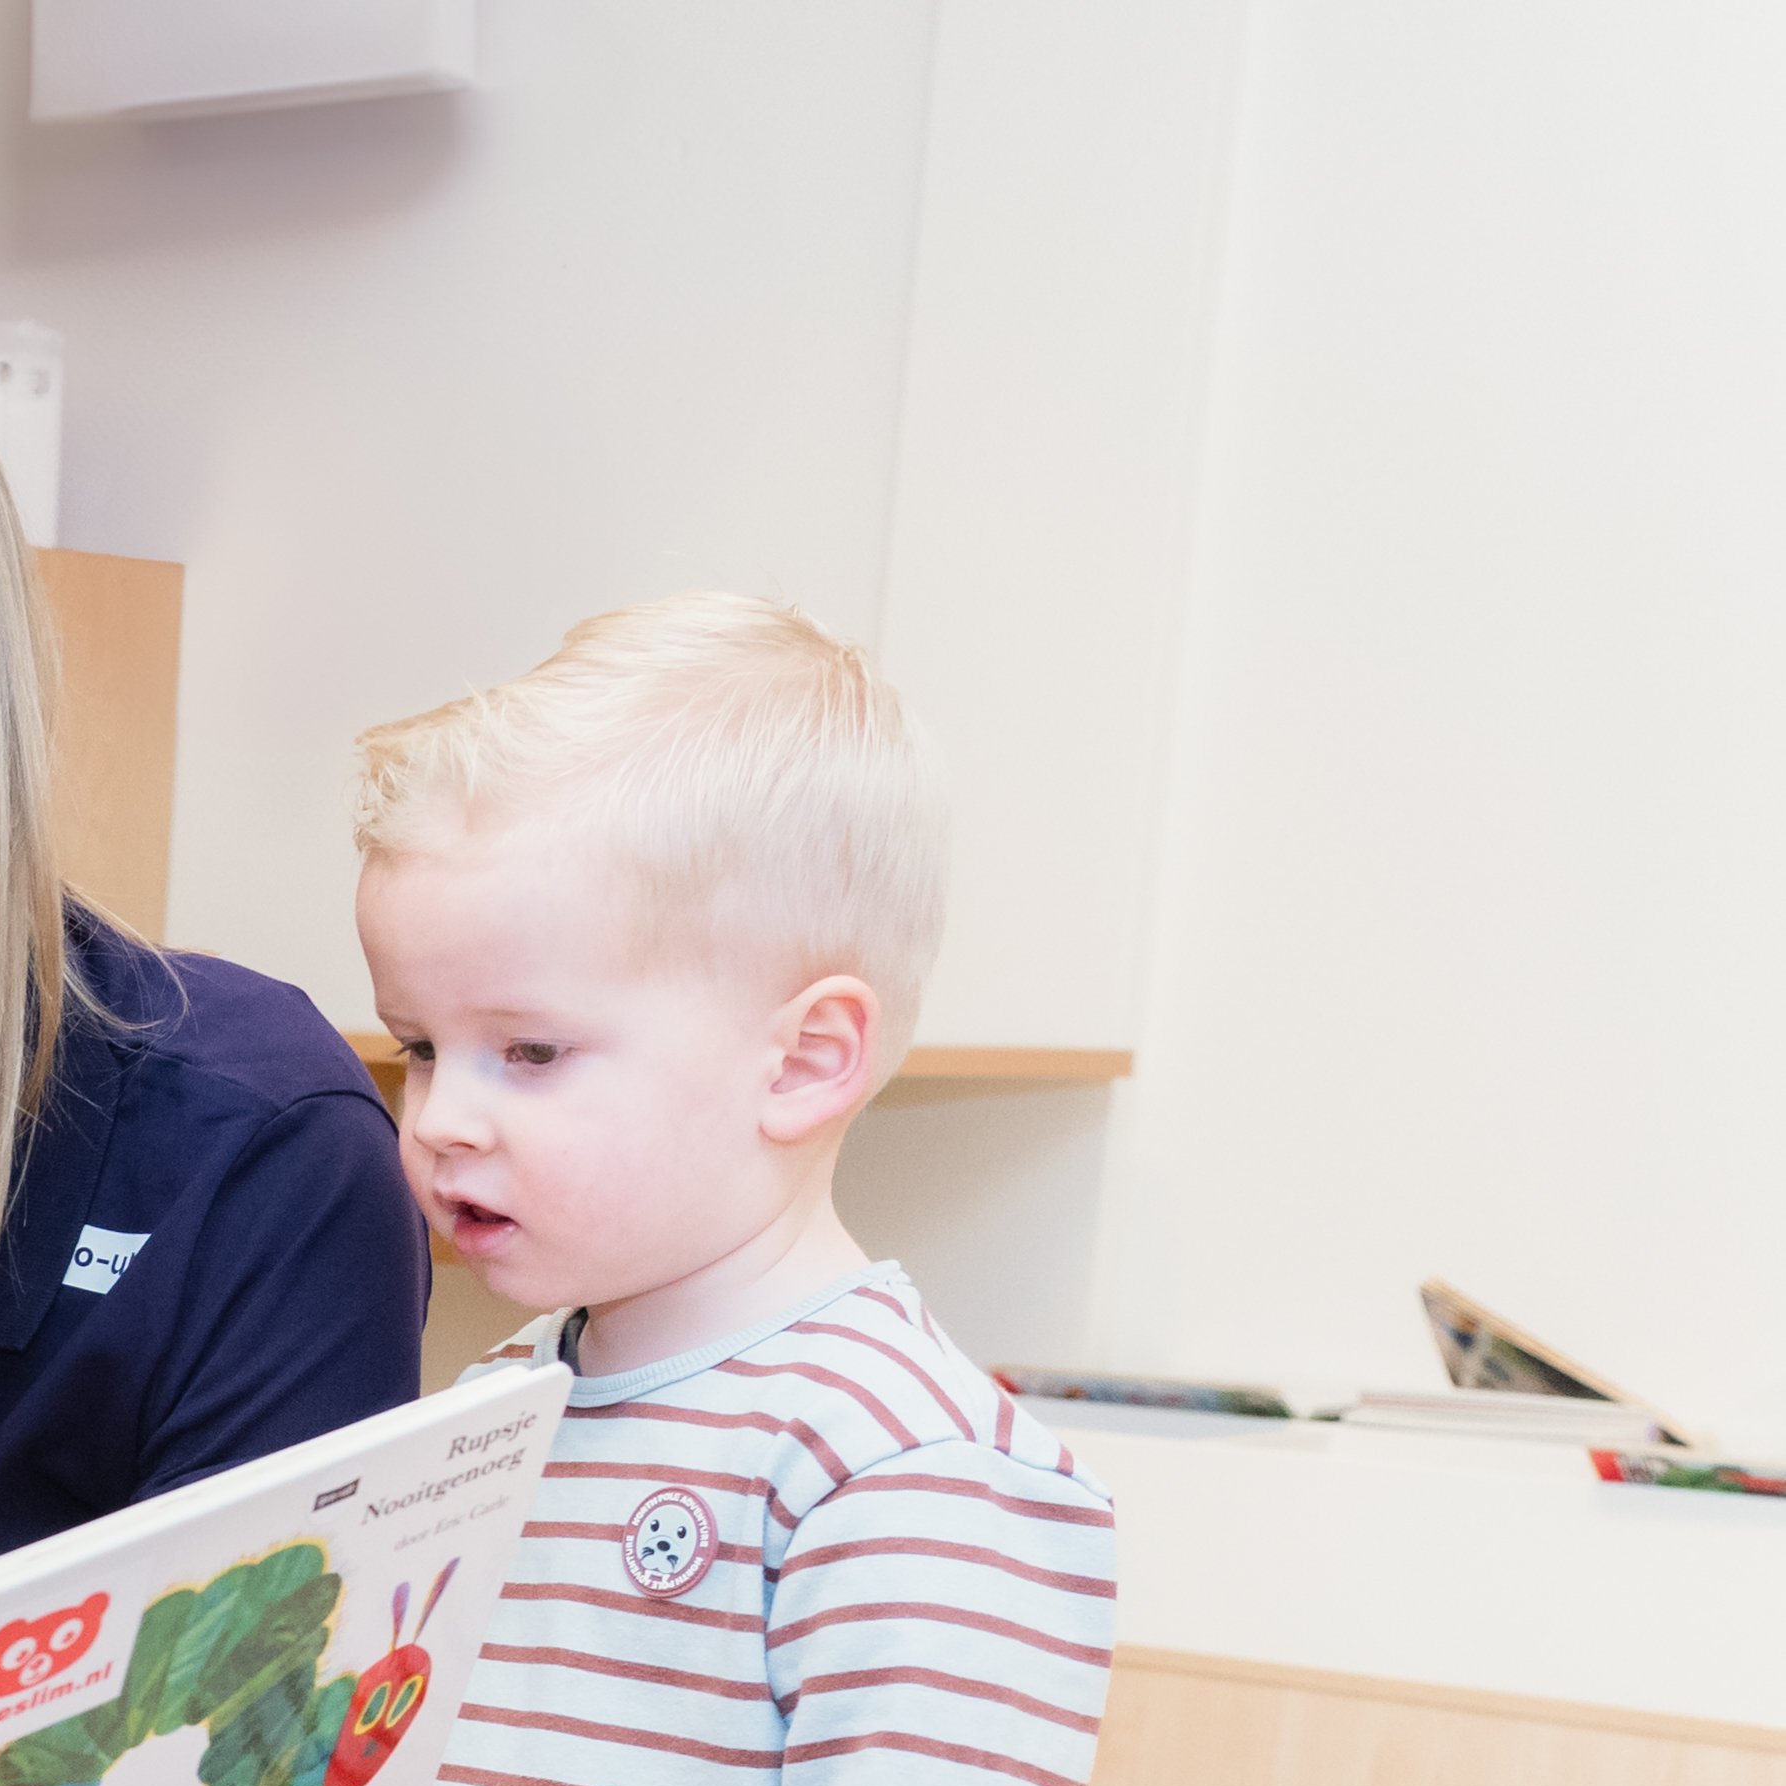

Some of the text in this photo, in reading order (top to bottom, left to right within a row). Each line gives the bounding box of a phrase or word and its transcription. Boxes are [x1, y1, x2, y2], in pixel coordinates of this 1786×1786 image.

[447, 1411, 537, 1460] Rupsje
[361, 1447, 526, 1525] Nooitgenoeg
[434, 1513, 465, 1535] Eric
[469, 1495, 510, 1519] Carle
[632, 1492, 709, 1548] NORTH POLE ADVENTURE
